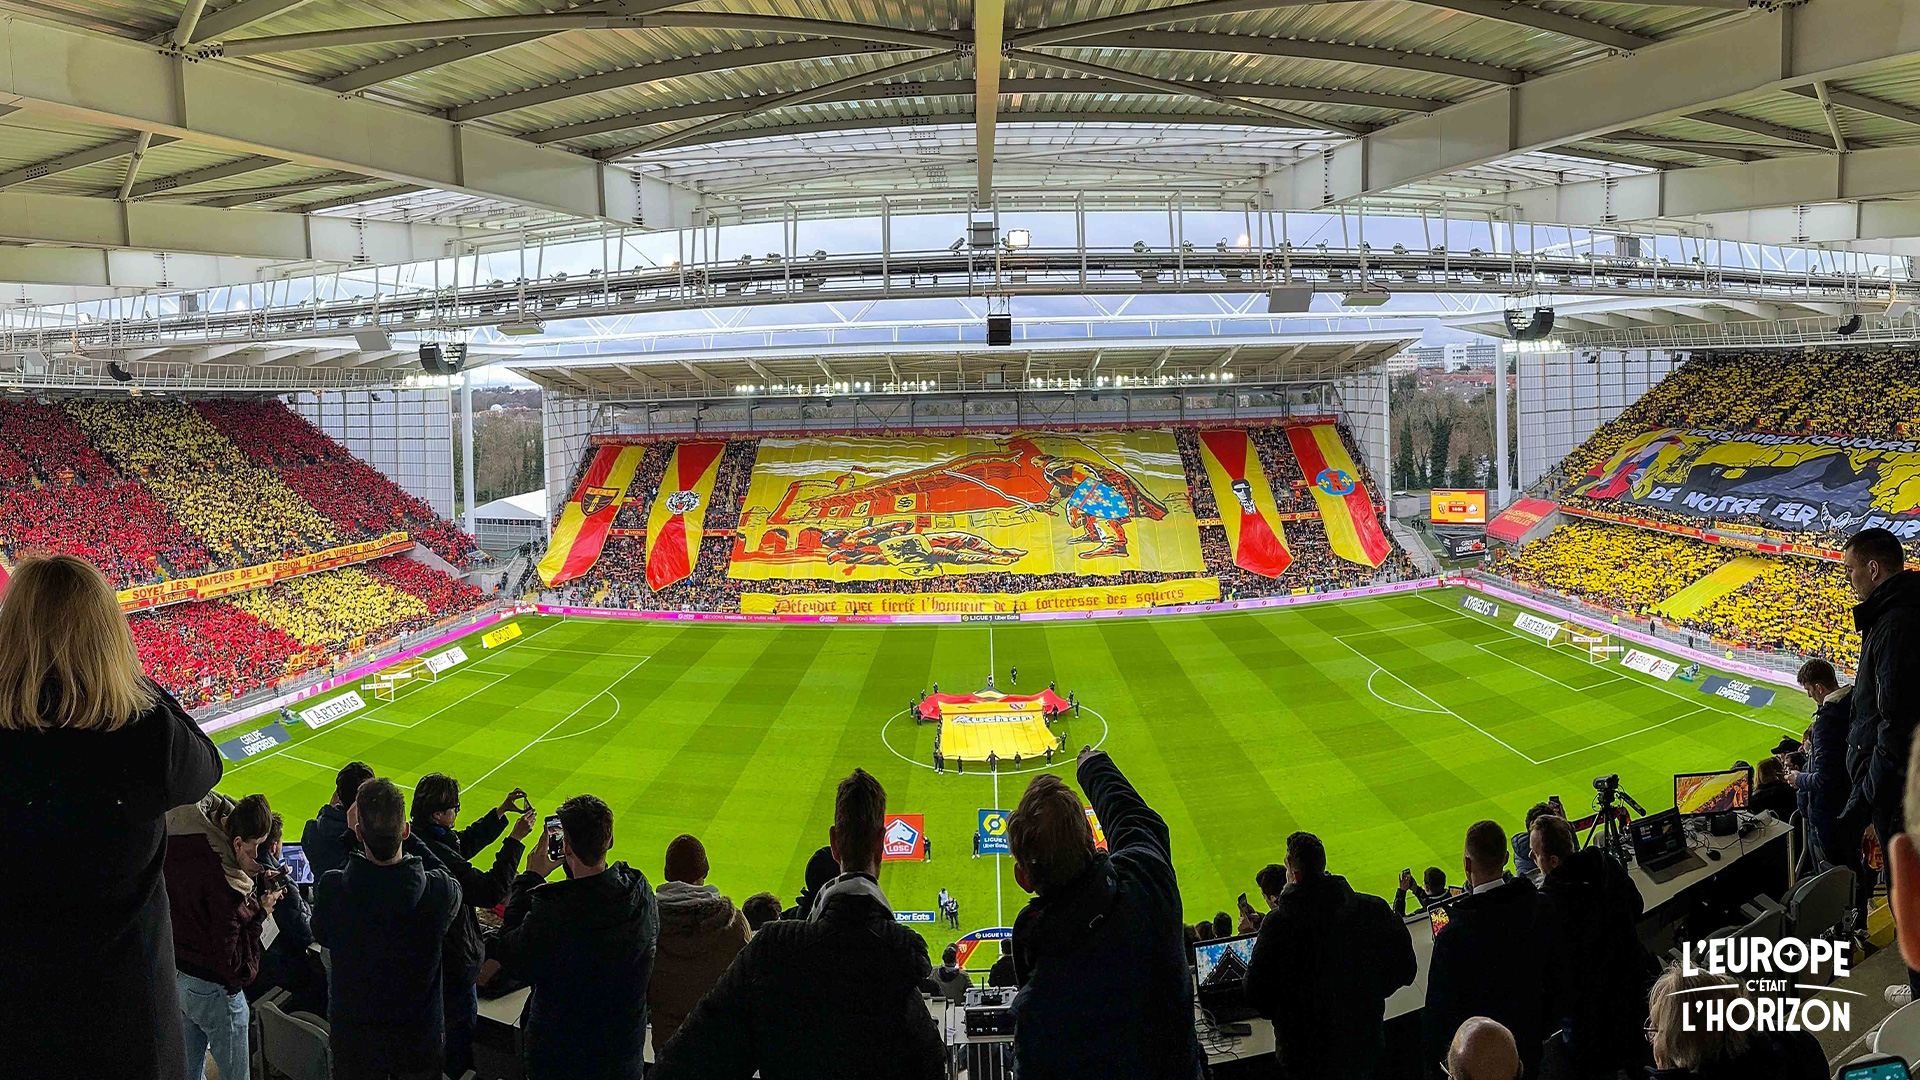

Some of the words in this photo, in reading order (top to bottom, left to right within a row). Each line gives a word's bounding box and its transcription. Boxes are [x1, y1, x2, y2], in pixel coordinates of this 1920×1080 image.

[1687, 428, 1735, 441] VOUS
[1647, 486, 1683, 502] DE
[1681, 491, 1769, 515] NOTRE
[1770, 502, 1819, 527] FER
[132, 586, 165, 600] SOYEZ
[170, 580, 189, 592] LES
[240, 569, 253, 579] DE
[256, 565, 268, 575] LA
[306, 551, 332, 565] FAITES
[333, 545, 359, 557] VIBRER
[362, 541, 376, 552] NOS
[377, 533, 404, 549] CORONS
[1443, 578, 1466, 586] Auchan
[881, 598, 916, 613] fierté
[993, 600, 1006, 612] de
[1036, 595, 1100, 611] forteresse
[1106, 593, 1128, 605] des
[1519, 615, 1556, 638] ARTEMIS
[1728, 680, 1752, 695] GROUPE
[312, 695, 360, 723] ARTEMIS
[952, 714, 1035, 725] Auchan
[239, 729, 266, 745] GROUPE
[894, 913, 912, 921] Uber
[911, 913, 931, 921] Eats
